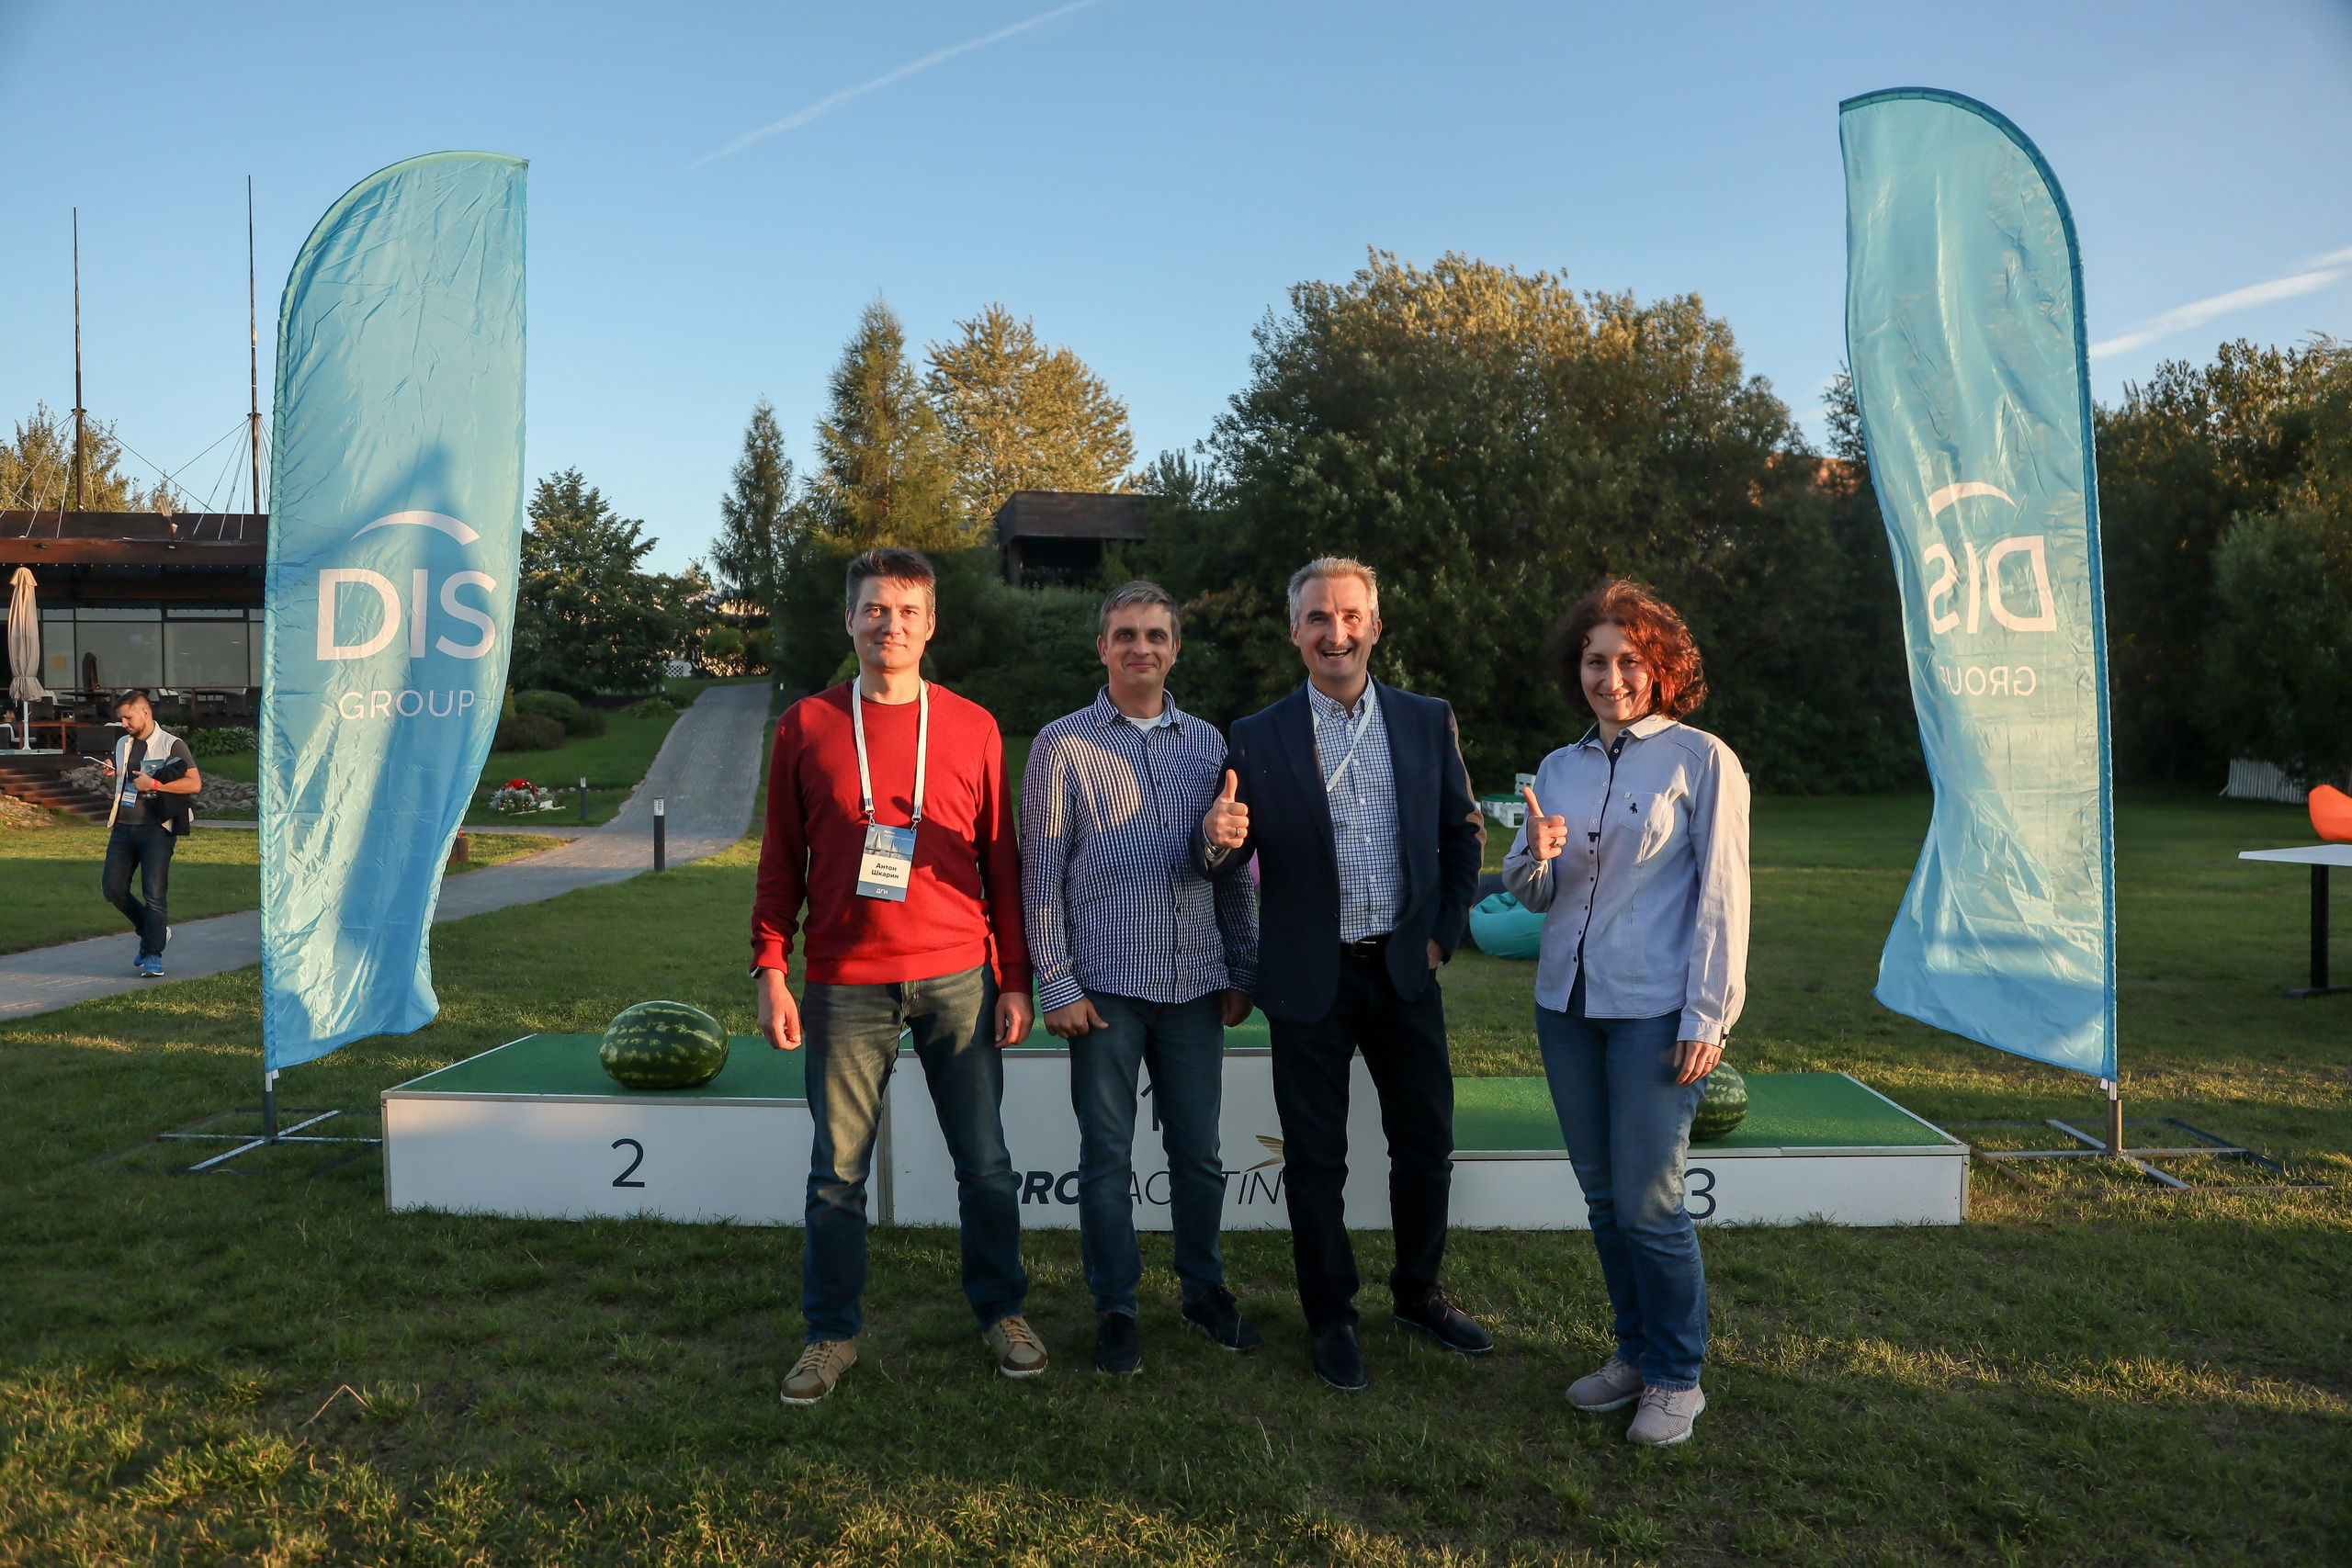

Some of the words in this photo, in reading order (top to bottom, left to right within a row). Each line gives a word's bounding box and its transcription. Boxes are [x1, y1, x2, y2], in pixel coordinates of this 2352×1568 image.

[317, 568, 497, 661] DIS
[338, 689, 476, 720] GROUP
[871, 869, 899, 879] Шкарин
[876, 863, 898, 872] Антон
[1140, 1082, 1160, 1132] 1
[611, 1137, 645, 1188] 2
[1683, 1167, 1716, 1220] 3
